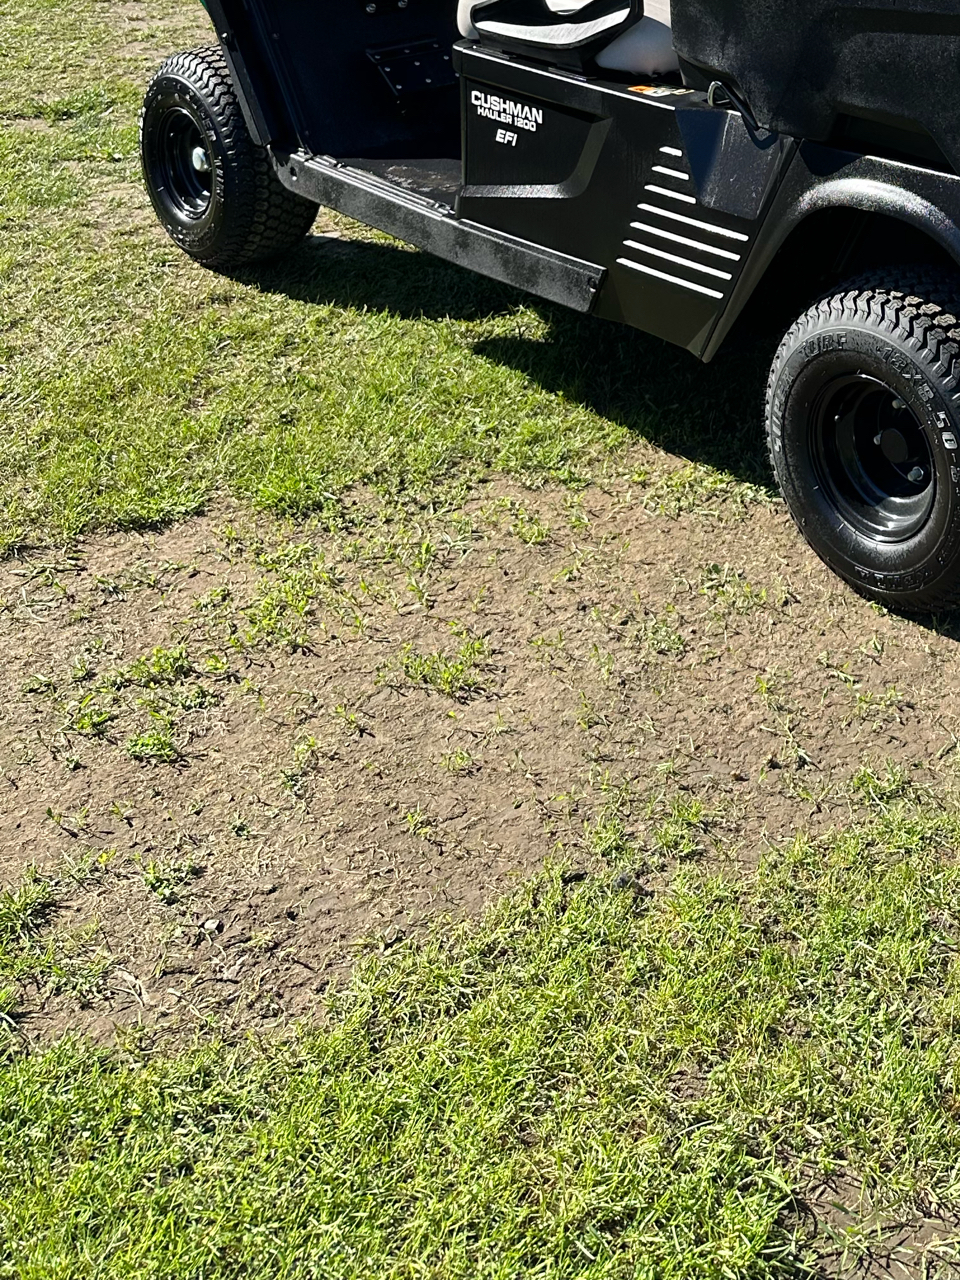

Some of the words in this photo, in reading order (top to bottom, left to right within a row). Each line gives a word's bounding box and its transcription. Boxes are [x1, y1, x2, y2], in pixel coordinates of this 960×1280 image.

[470, 90, 543, 125] CUSHMAN
[477, 106, 512, 125] HAULER
[513, 116, 537, 132] 1200
[495, 128, 518, 147] EFI
[800, 331, 847, 362] TURF
